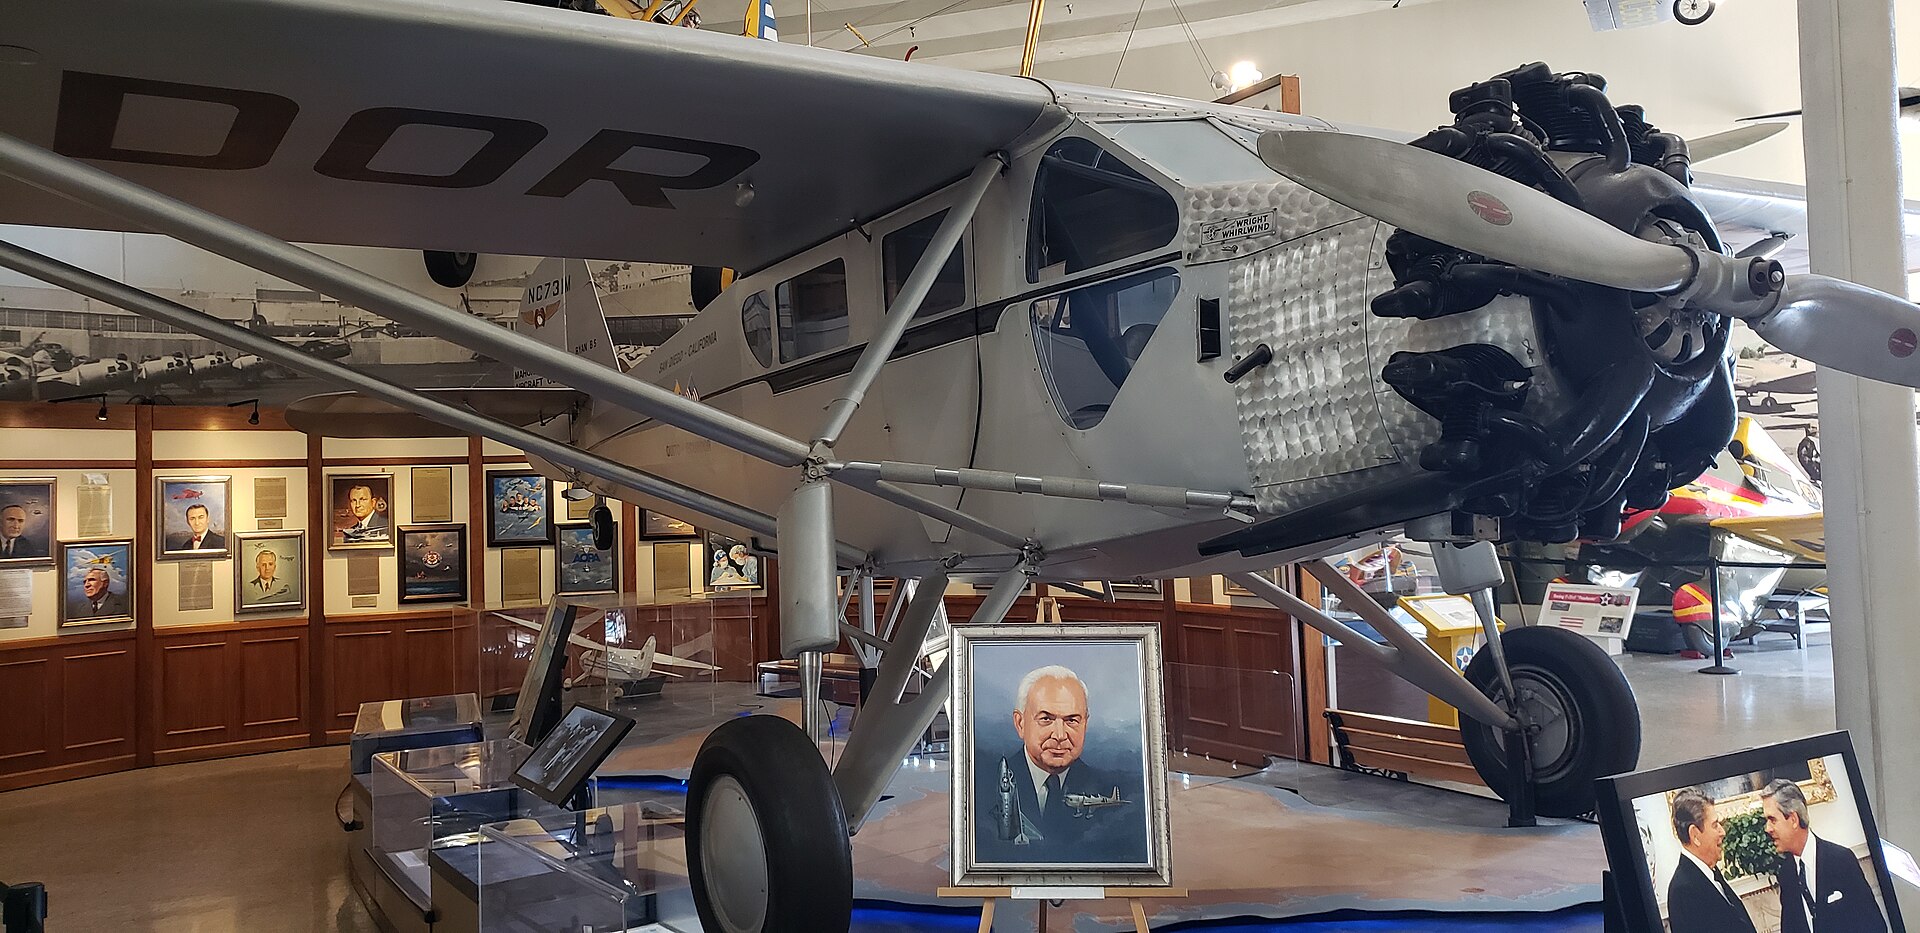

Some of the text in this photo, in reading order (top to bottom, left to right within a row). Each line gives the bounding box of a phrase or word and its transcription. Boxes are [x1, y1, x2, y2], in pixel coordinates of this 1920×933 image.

[1236, 214, 1269, 228] WRIGHT
[1222, 223, 1270, 238] WHIRLWIND
[528, 274, 571, 304] NC731M
[669, 350, 684, 368] DIEGO
[688, 330, 718, 357] CALIFORNIA
[572, 553, 601, 563] AOPA
